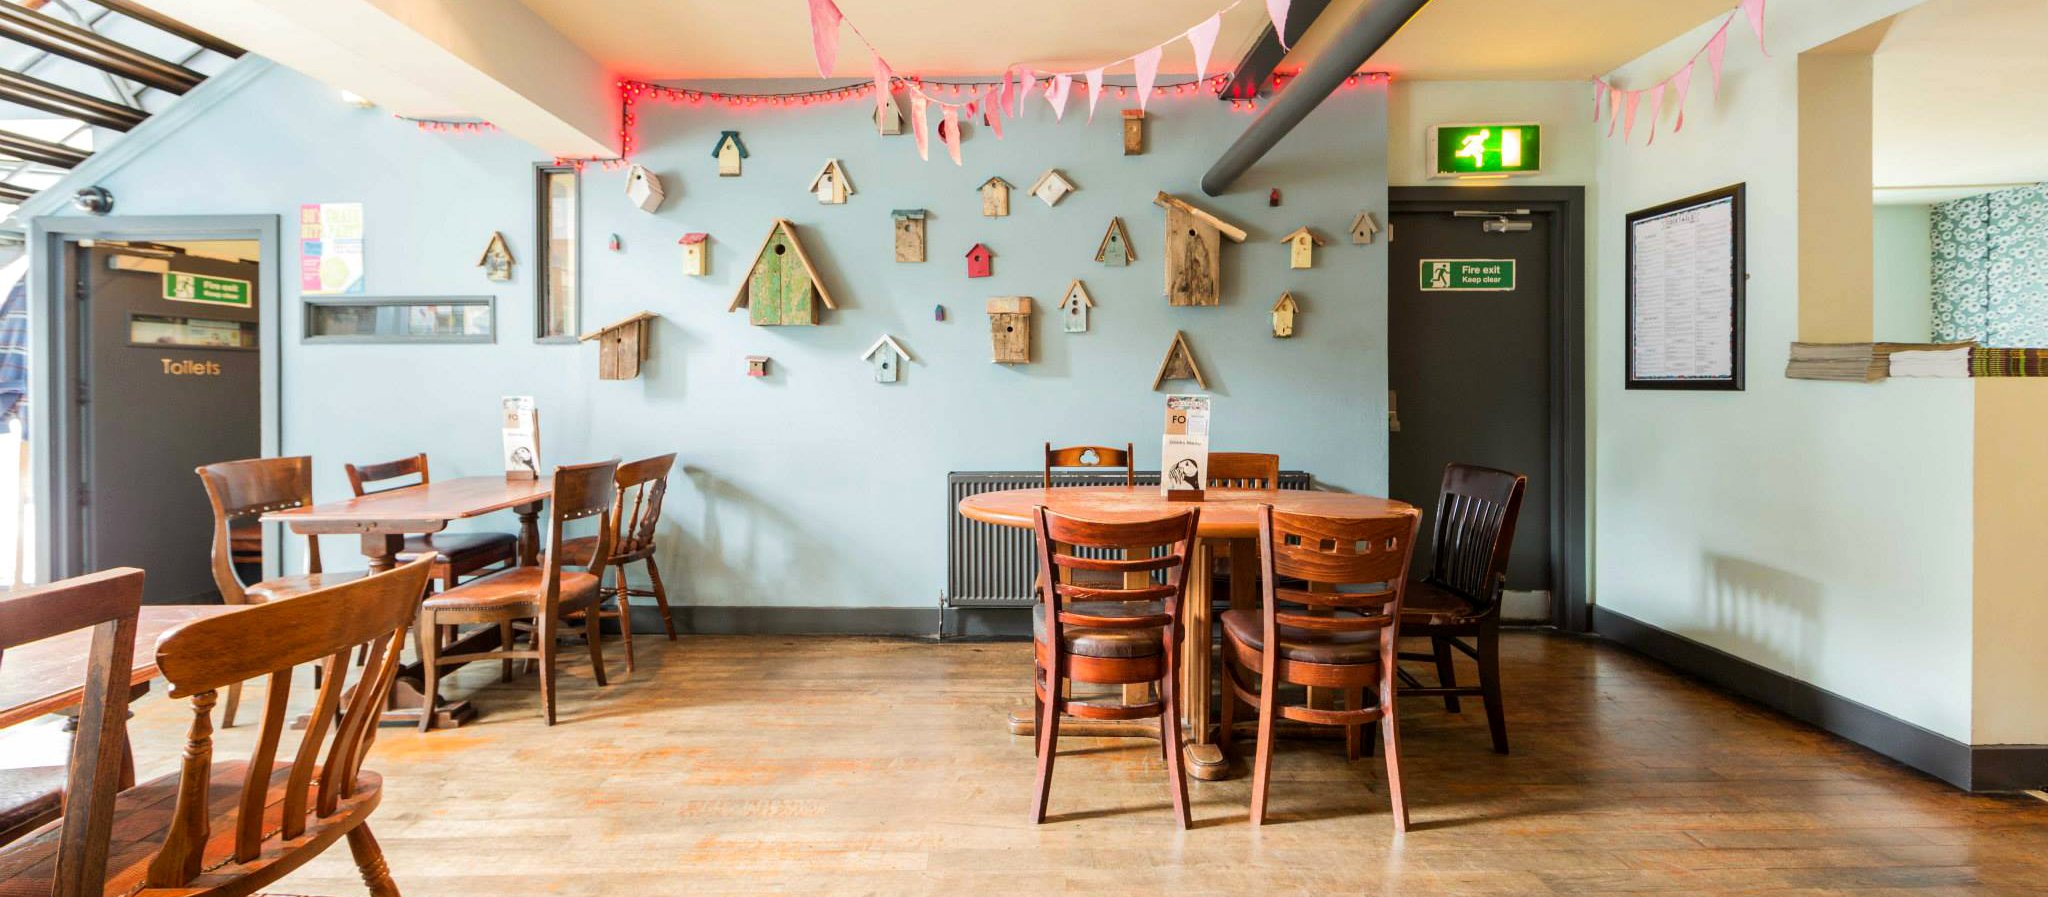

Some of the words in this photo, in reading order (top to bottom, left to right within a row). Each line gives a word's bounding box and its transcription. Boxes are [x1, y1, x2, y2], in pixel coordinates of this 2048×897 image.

[1462, 265, 1480, 275] Fire
[1483, 265, 1501, 275] exit
[1462, 276, 1481, 284] Keep
[1483, 276, 1502, 284] clear
[161, 358, 222, 375] Toilets
